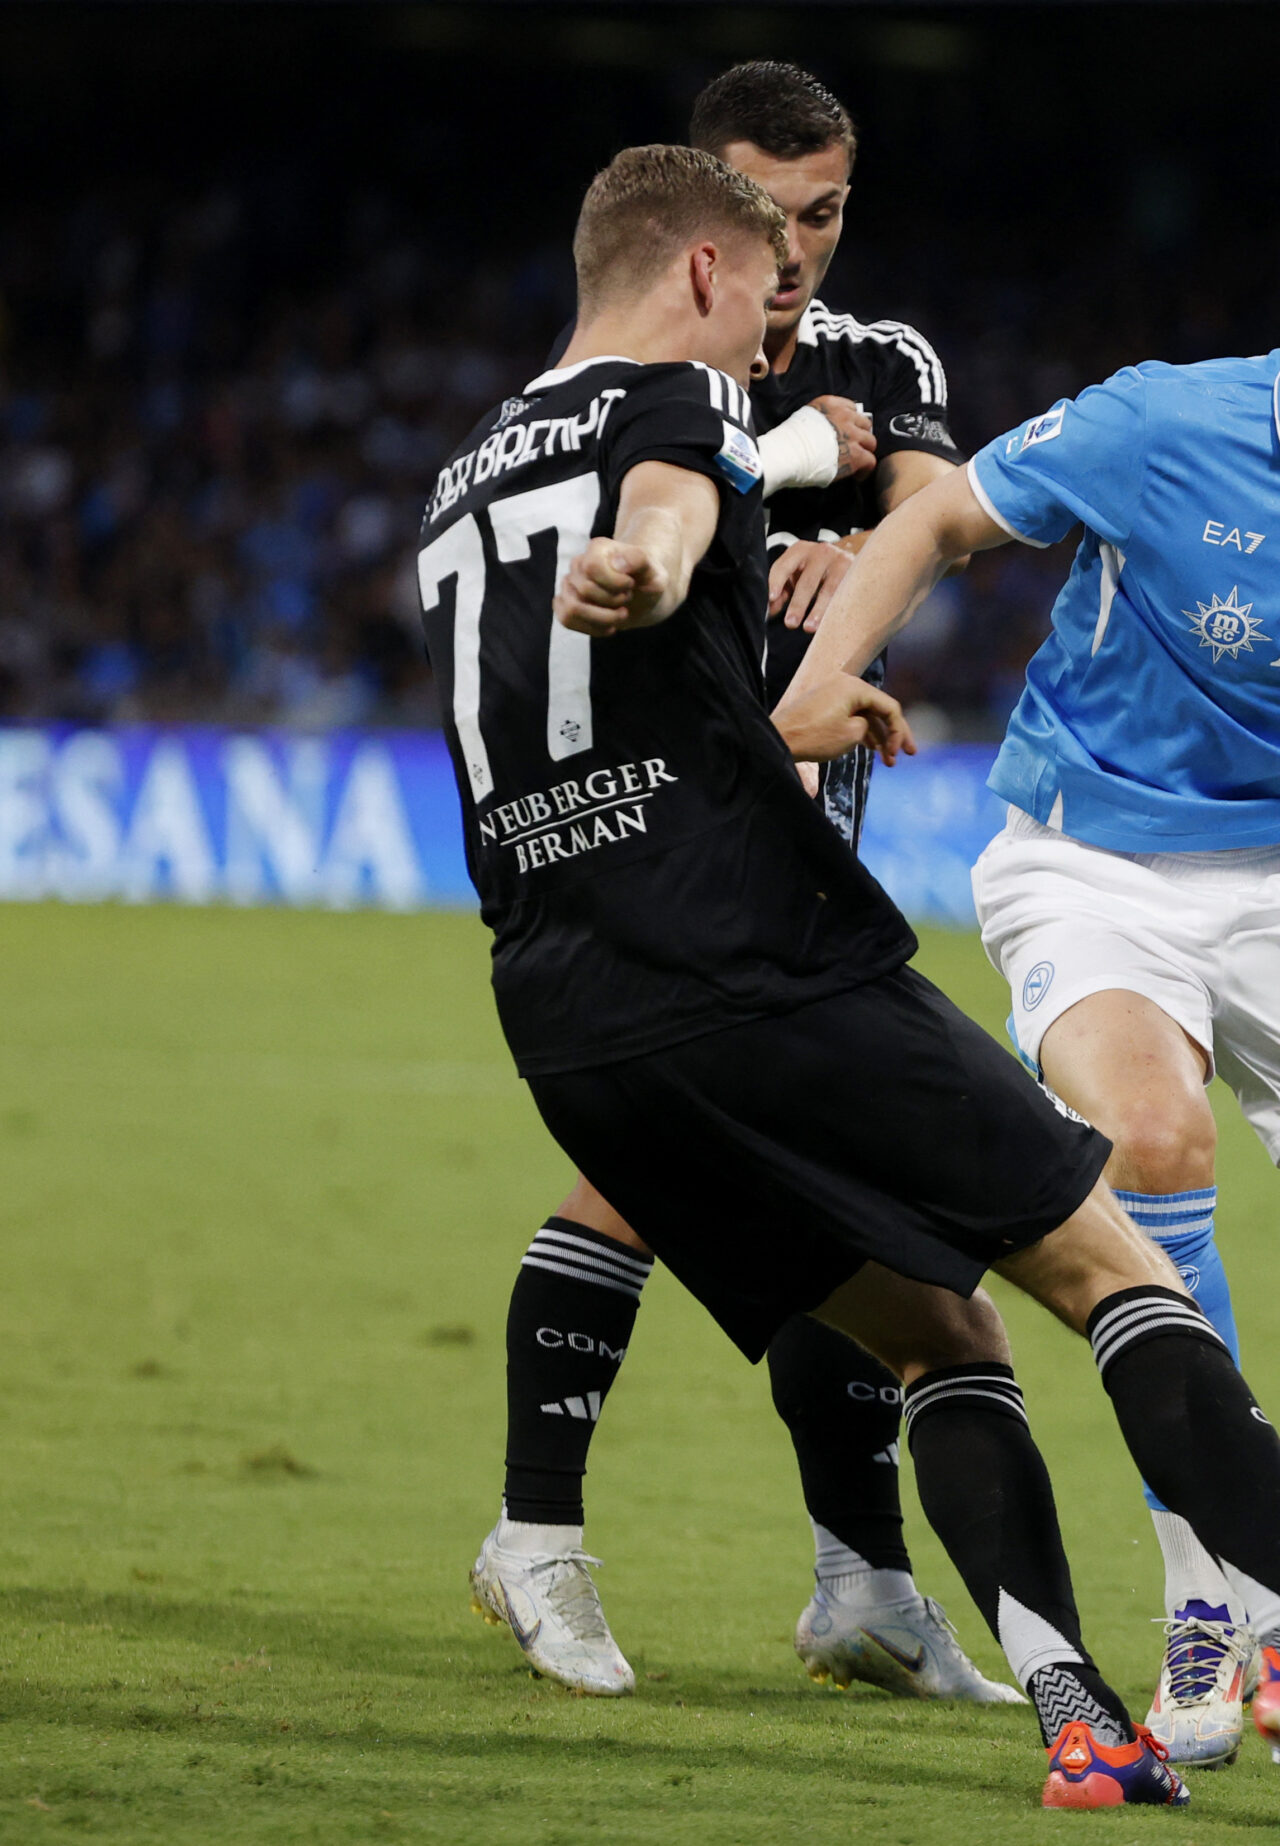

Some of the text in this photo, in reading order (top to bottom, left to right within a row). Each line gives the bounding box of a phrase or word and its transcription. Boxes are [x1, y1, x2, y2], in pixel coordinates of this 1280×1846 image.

[1202, 519, 1266, 555] EA7
[417, 470, 600, 804] 77
[479, 757, 679, 847] NEUBERGER
[514, 803, 648, 875] BERMAN
